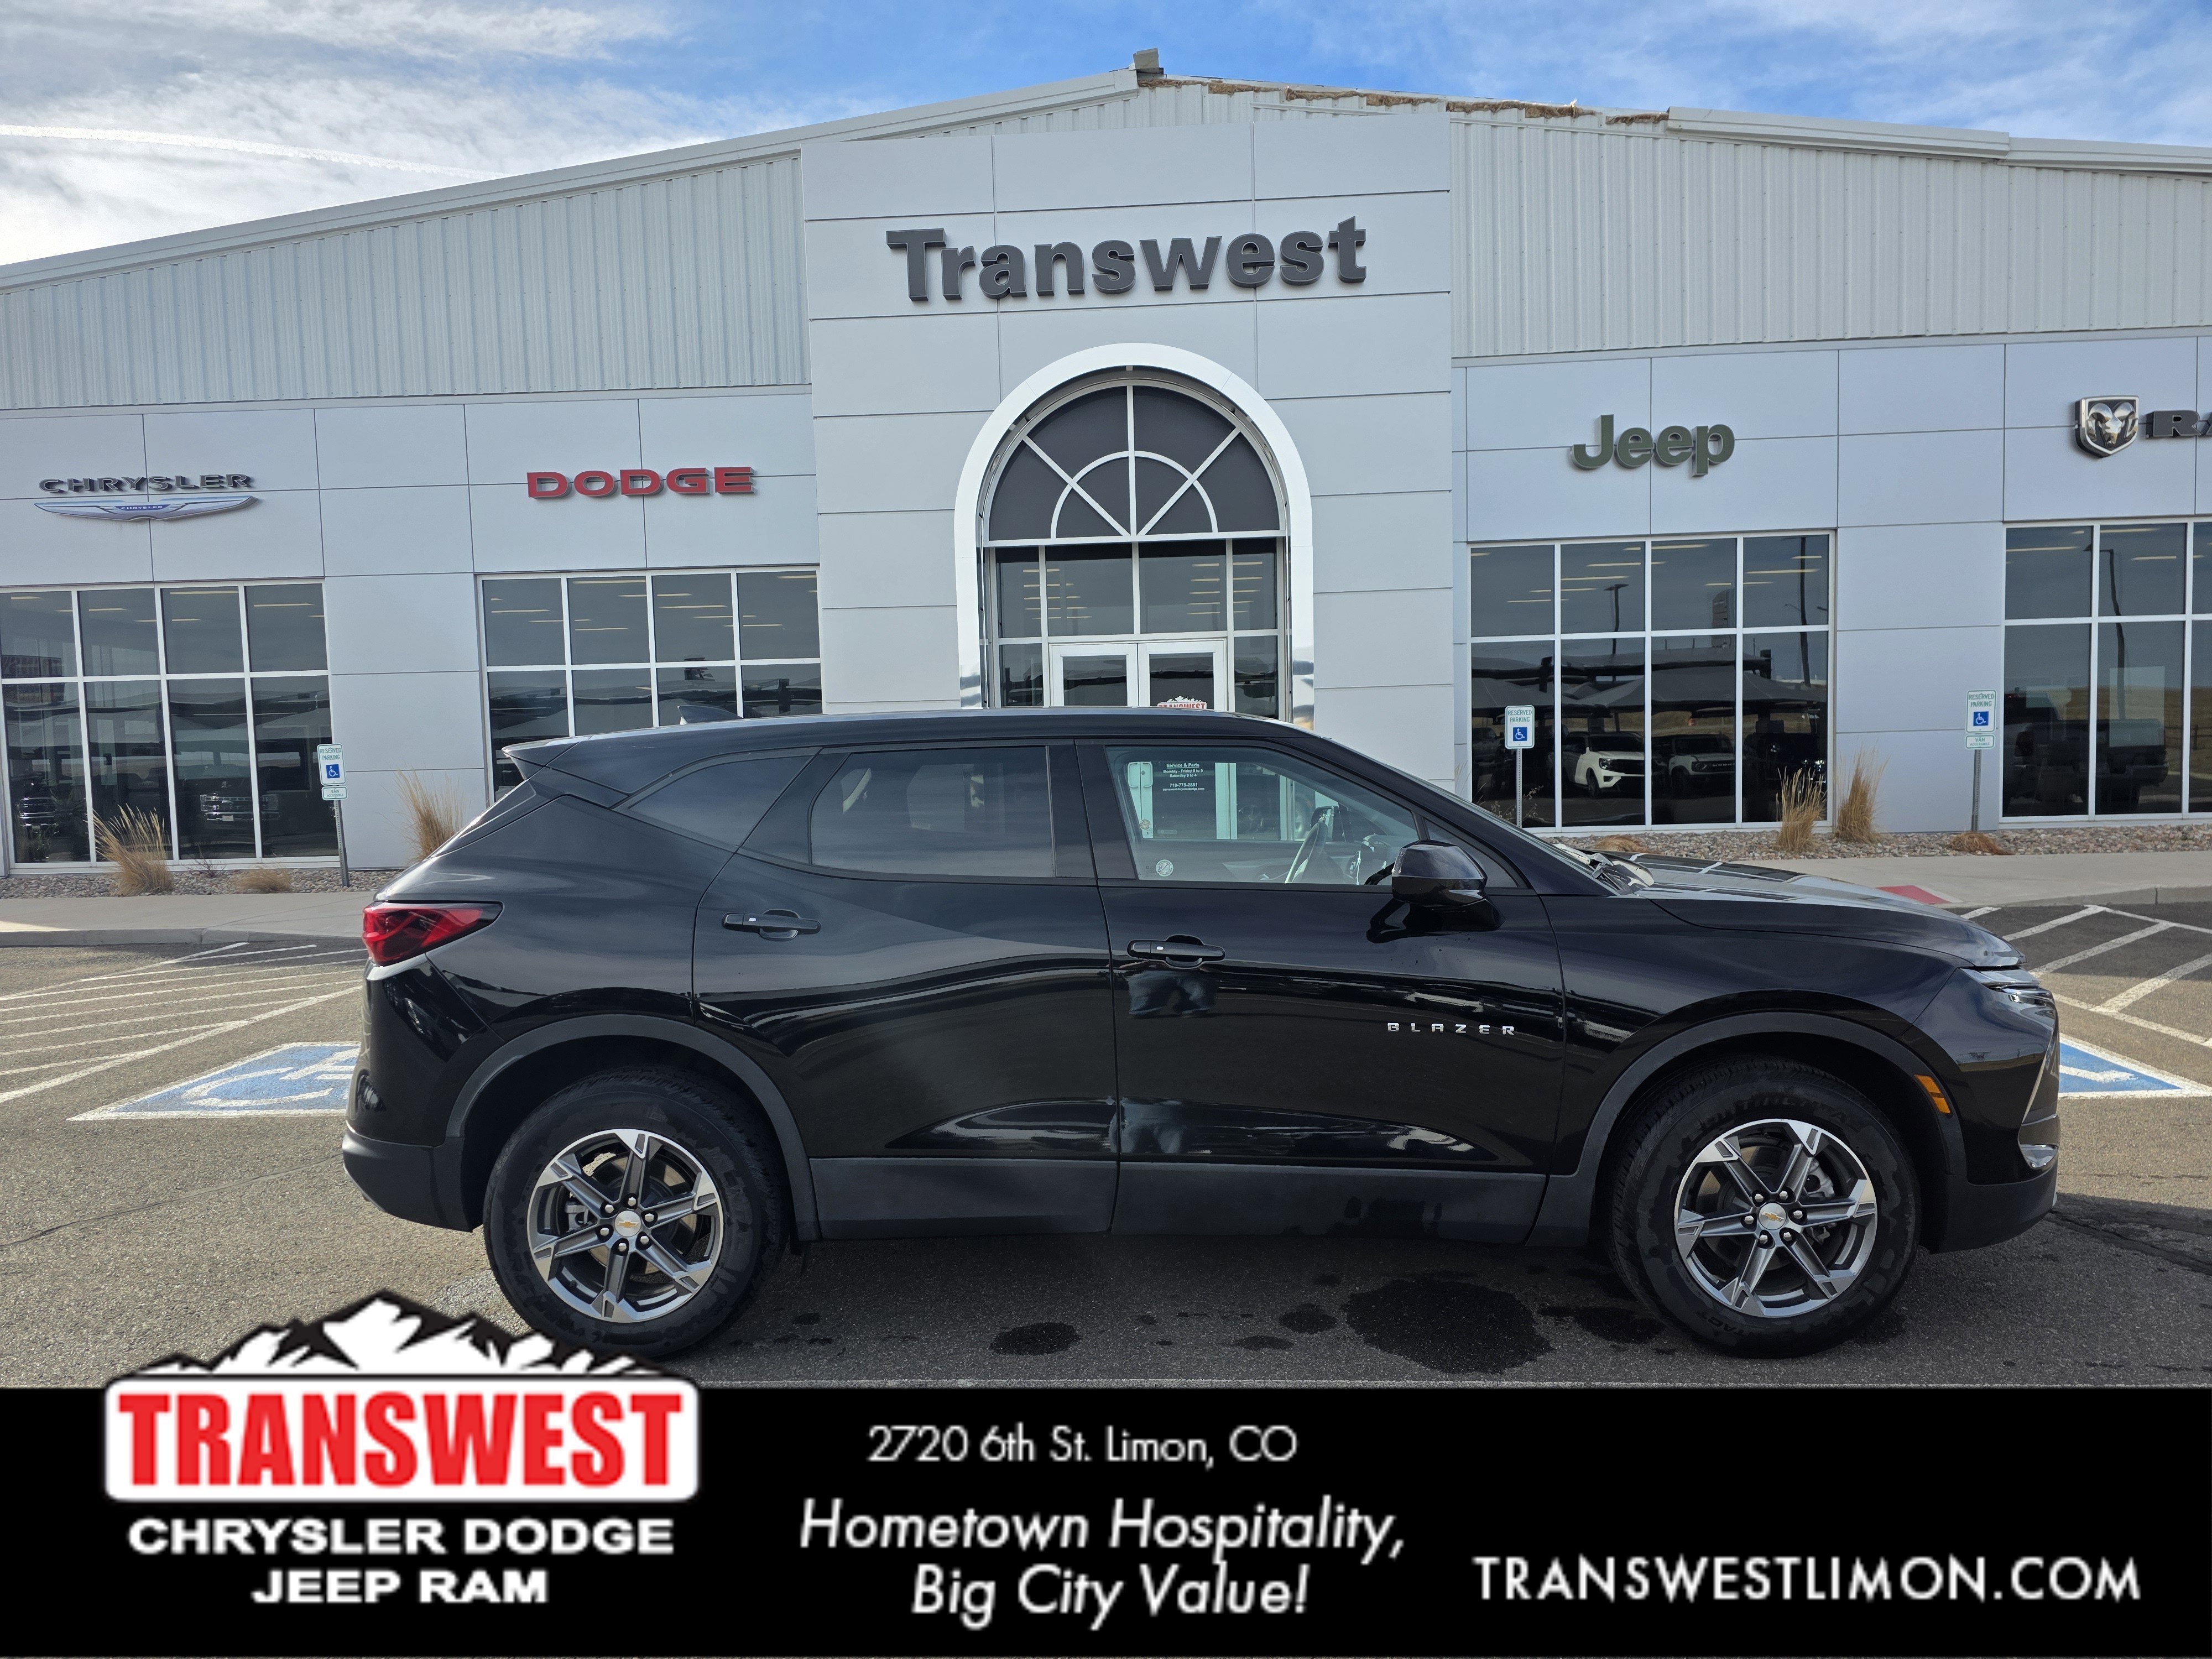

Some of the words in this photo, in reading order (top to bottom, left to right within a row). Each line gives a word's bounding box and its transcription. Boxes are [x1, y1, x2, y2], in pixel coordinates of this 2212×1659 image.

[886, 216, 1367, 301] Transwest
[2146, 410, 2212, 439] R
[1571, 414, 1735, 477] Jeep
[39, 473, 254, 494] CHRYSLER
[526, 466, 755, 498] DODGE
[1387, 1022, 1515, 1036] BLAZER
